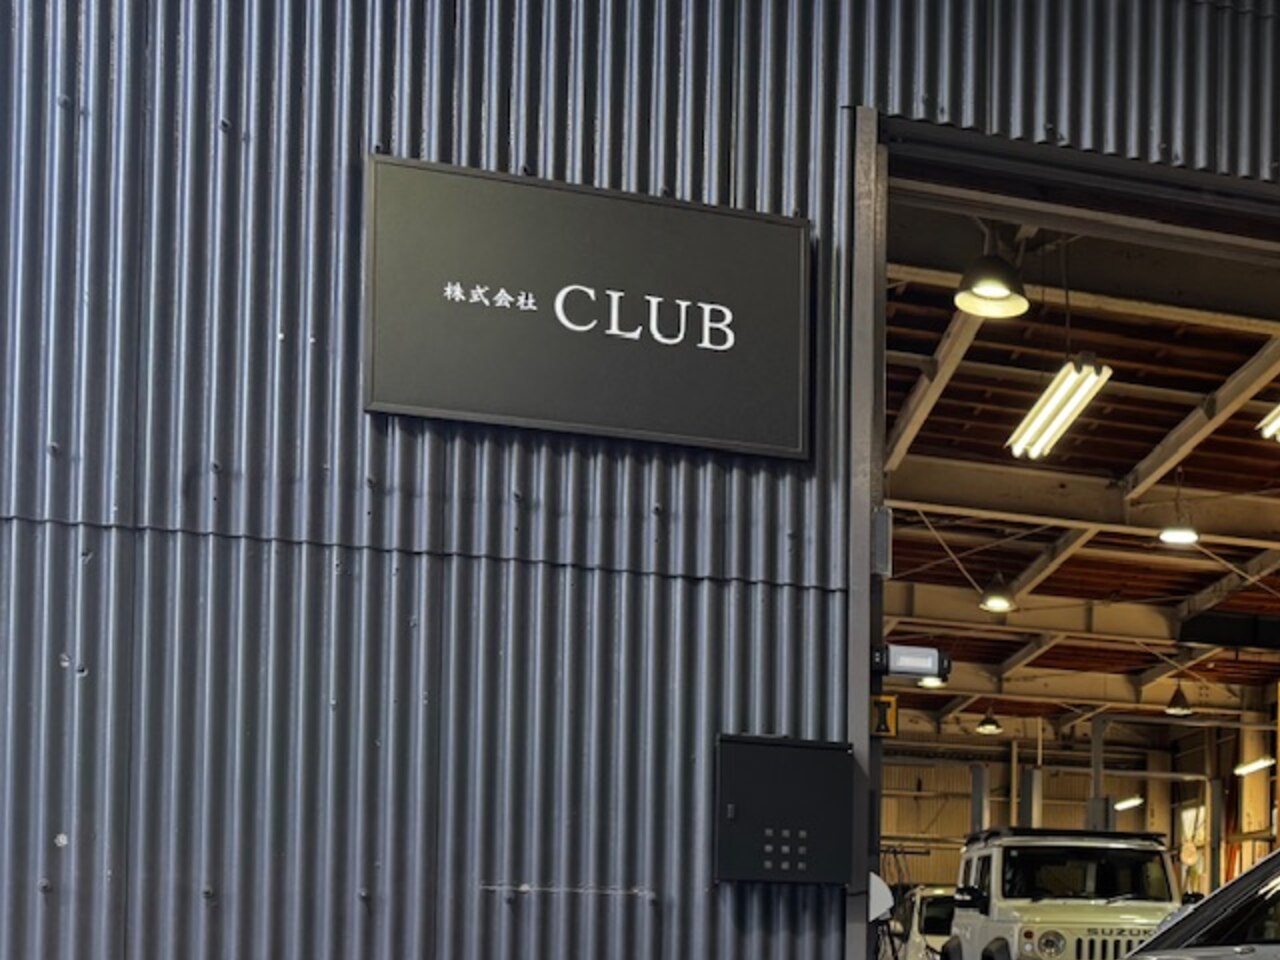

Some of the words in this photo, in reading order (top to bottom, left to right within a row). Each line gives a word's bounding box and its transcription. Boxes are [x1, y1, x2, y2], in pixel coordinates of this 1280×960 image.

[443, 281, 538, 311] 株式会社
[553, 284, 735, 351] CLUB
